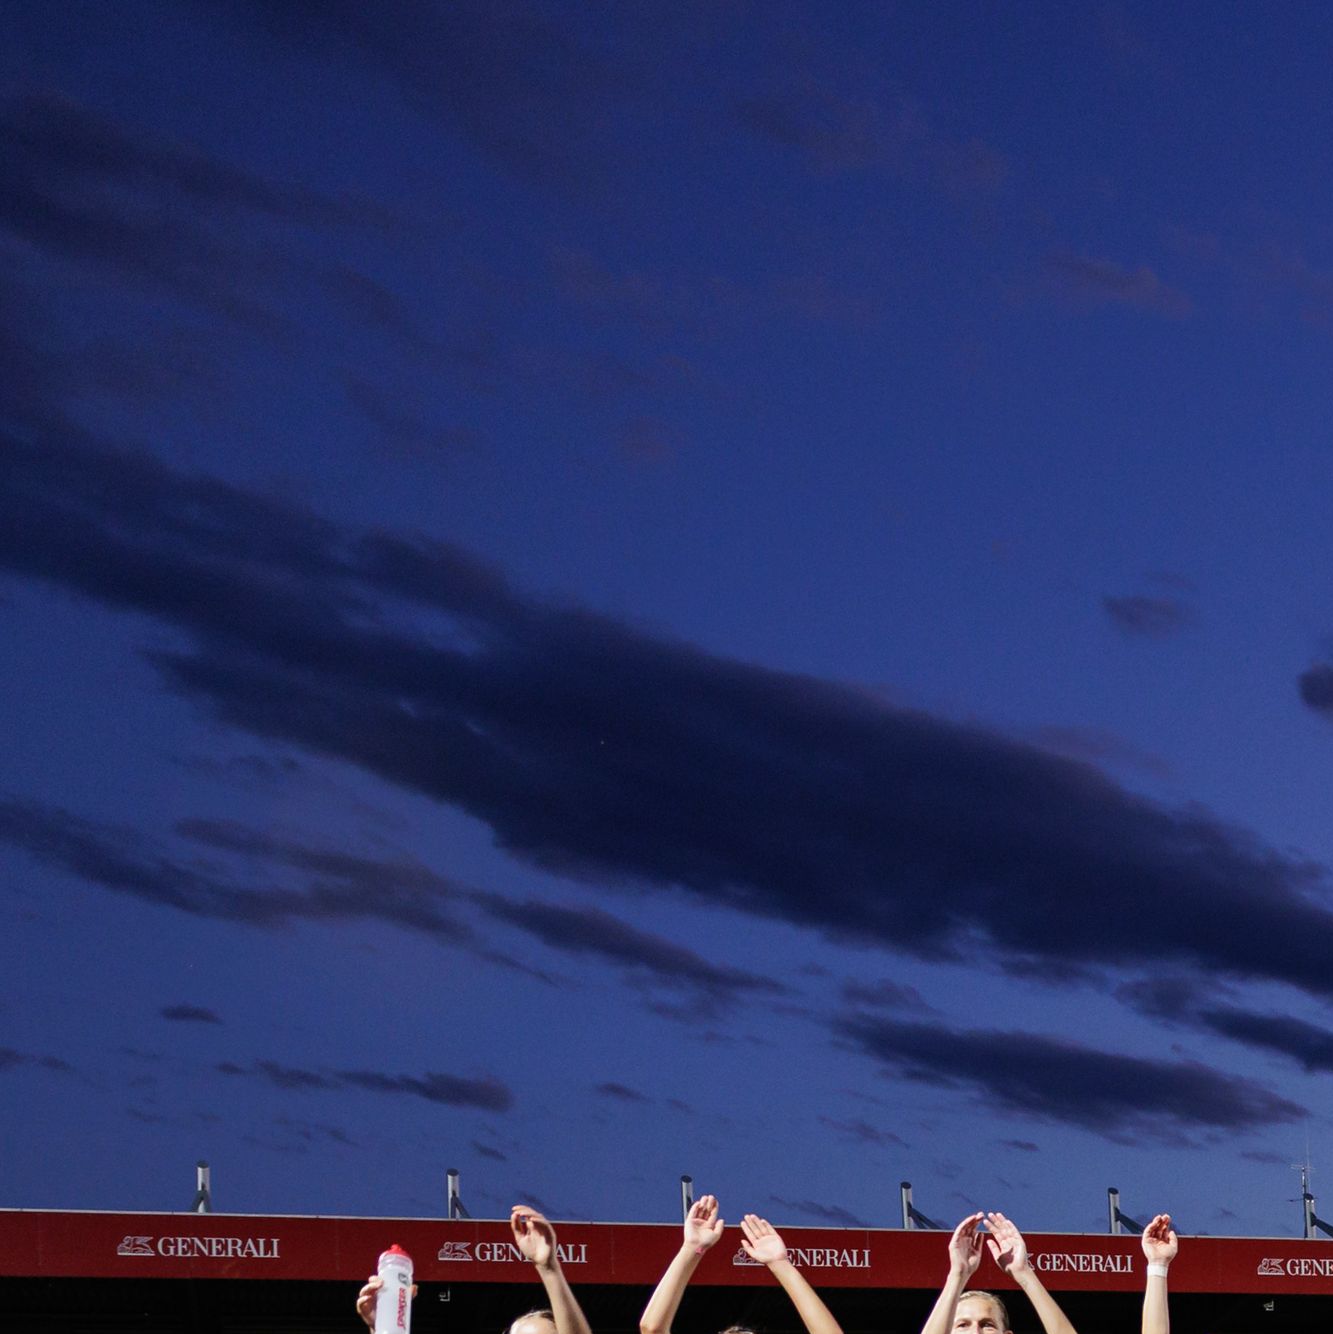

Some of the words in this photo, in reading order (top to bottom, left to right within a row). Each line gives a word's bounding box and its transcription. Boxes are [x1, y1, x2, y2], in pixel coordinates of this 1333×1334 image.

[157, 1237, 280, 1258] GENERALI
[475, 1243, 588, 1264] GENALI
[784, 1248, 872, 1268] ENERALI
[1037, 1254, 1133, 1272] GENERALI
